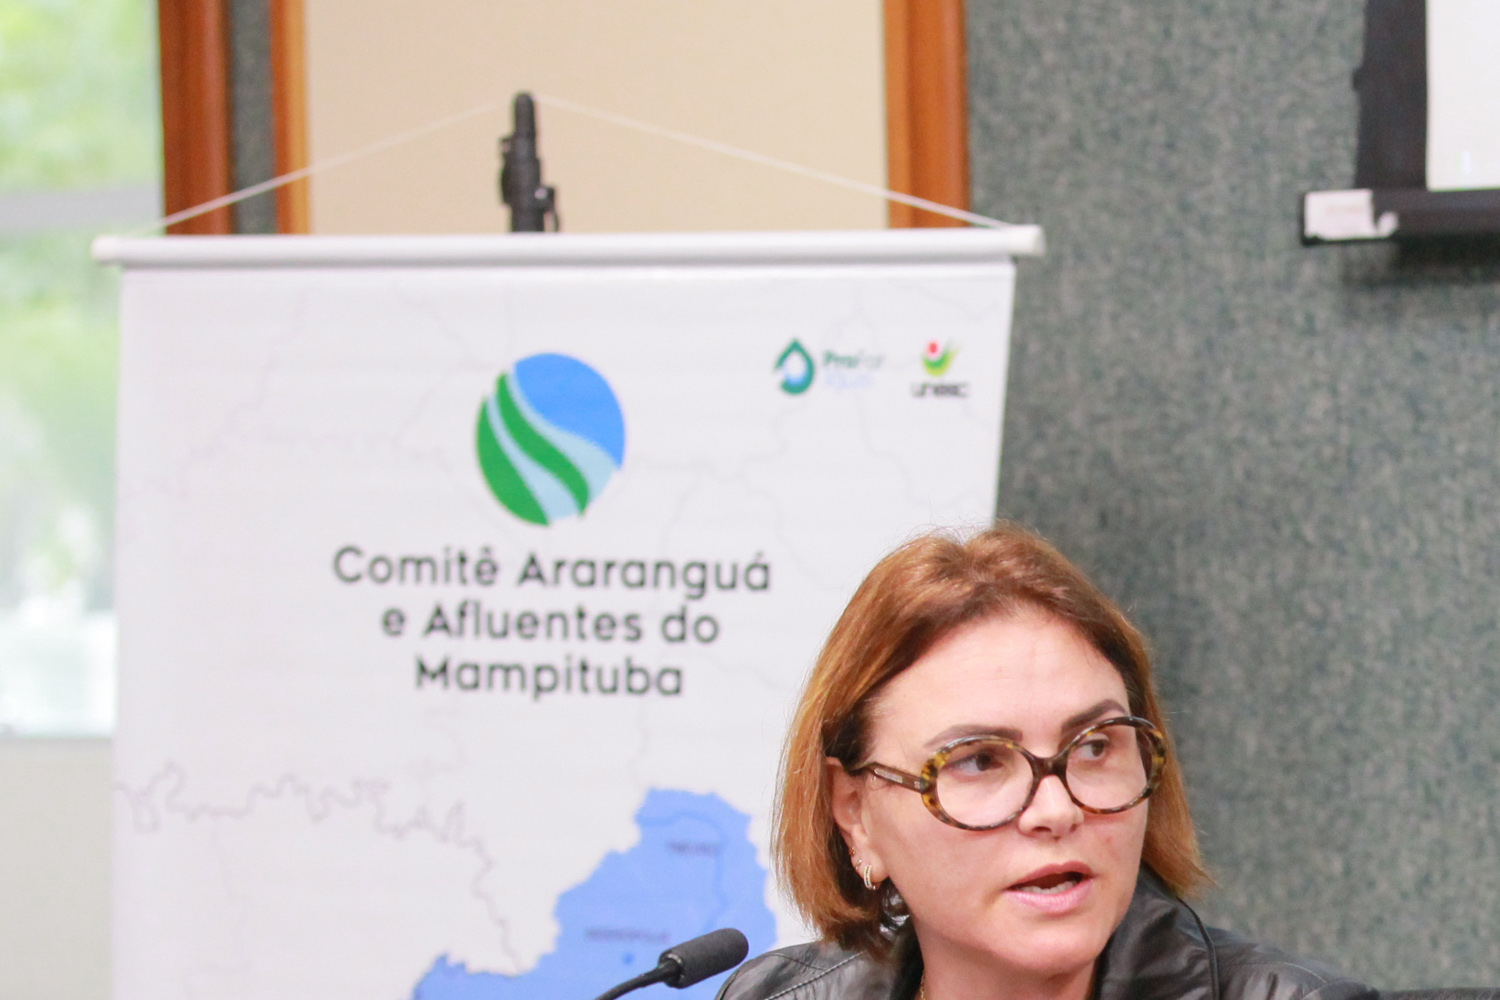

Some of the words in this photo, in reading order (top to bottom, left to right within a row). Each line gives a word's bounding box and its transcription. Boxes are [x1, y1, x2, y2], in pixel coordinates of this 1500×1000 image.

[333, 545, 500, 587] Comitê
[517, 552, 771, 601] Araranguá
[381, 608, 407, 637] e
[423, 599, 643, 643] Afluentes
[660, 605, 720, 645] do
[416, 657, 683, 700] Mampituba
